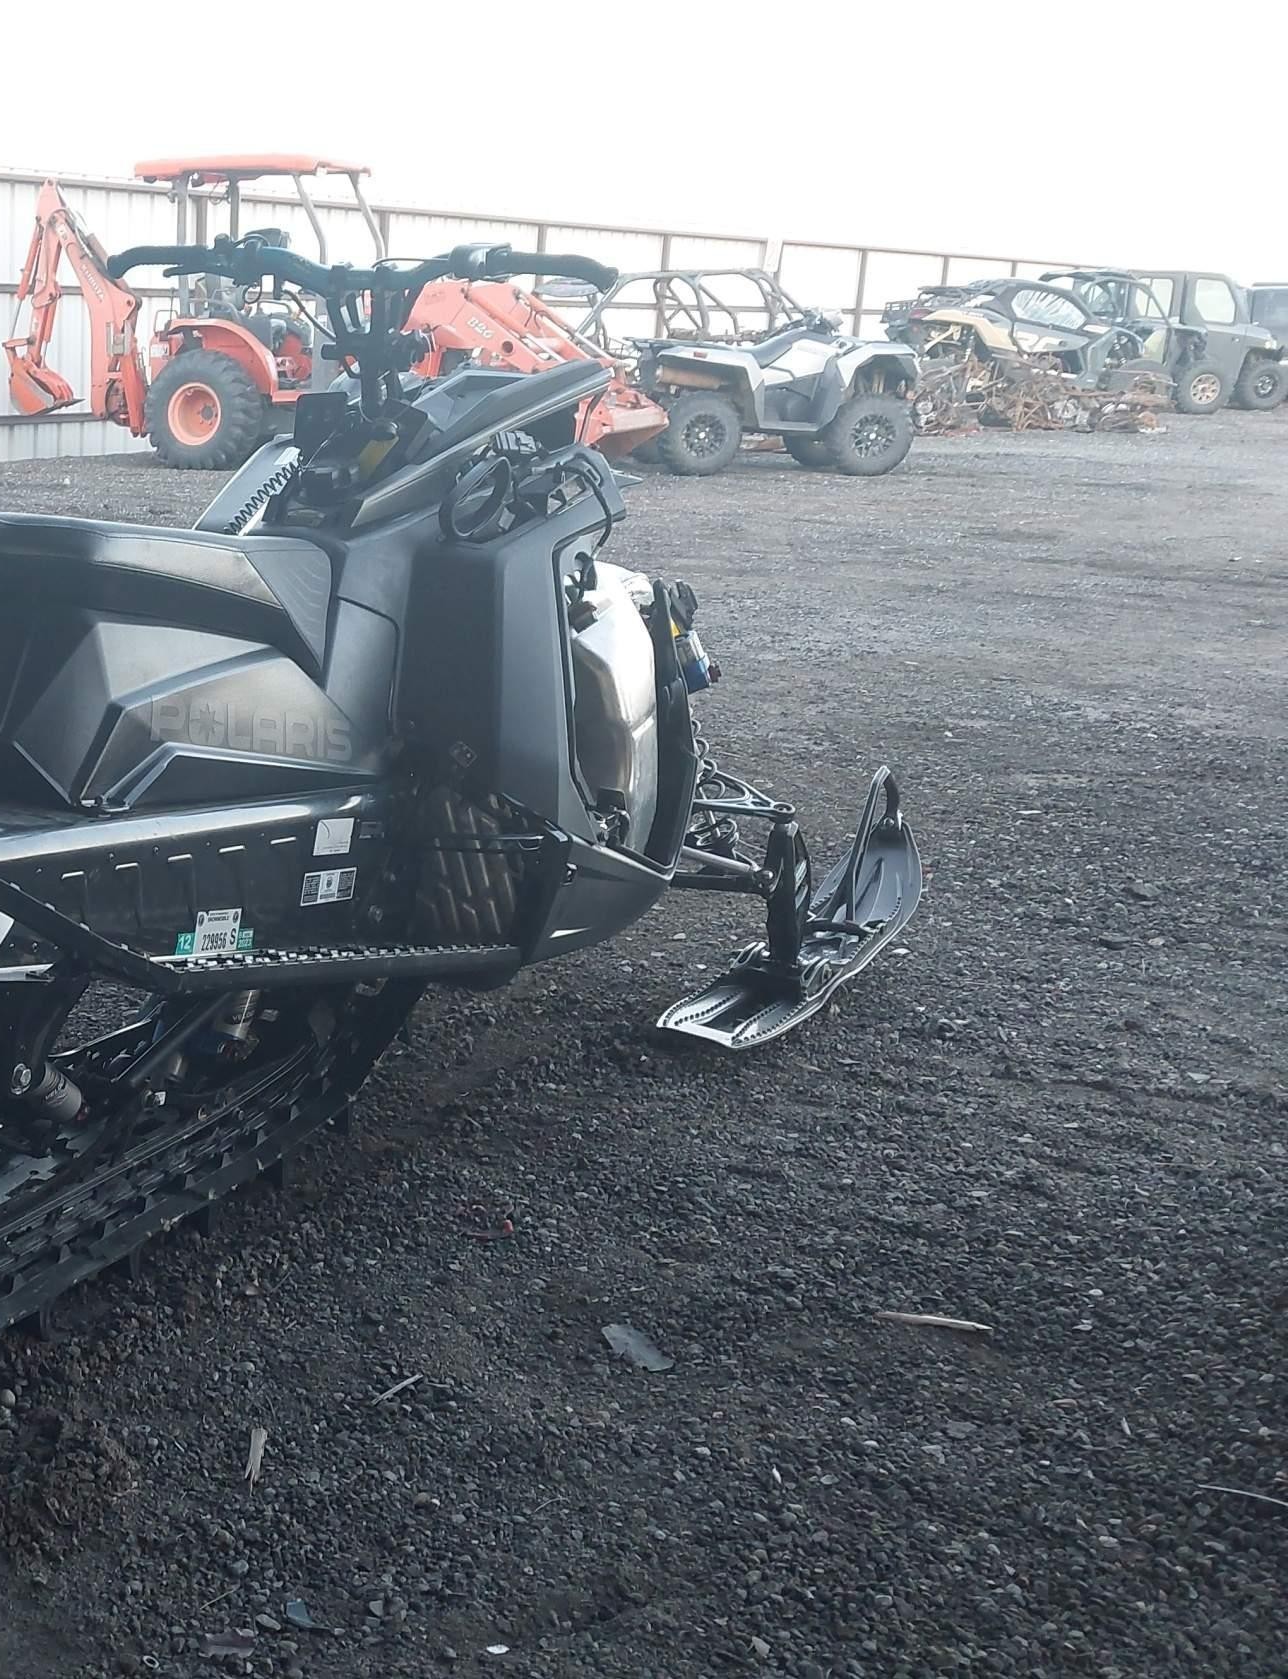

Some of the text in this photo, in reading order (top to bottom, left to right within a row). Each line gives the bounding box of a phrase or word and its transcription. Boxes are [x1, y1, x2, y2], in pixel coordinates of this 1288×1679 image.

[149, 694, 353, 762] POLARIS
[179, 934, 192, 951] 12
[201, 931, 228, 951] 229956
[229, 927, 237, 945] S
